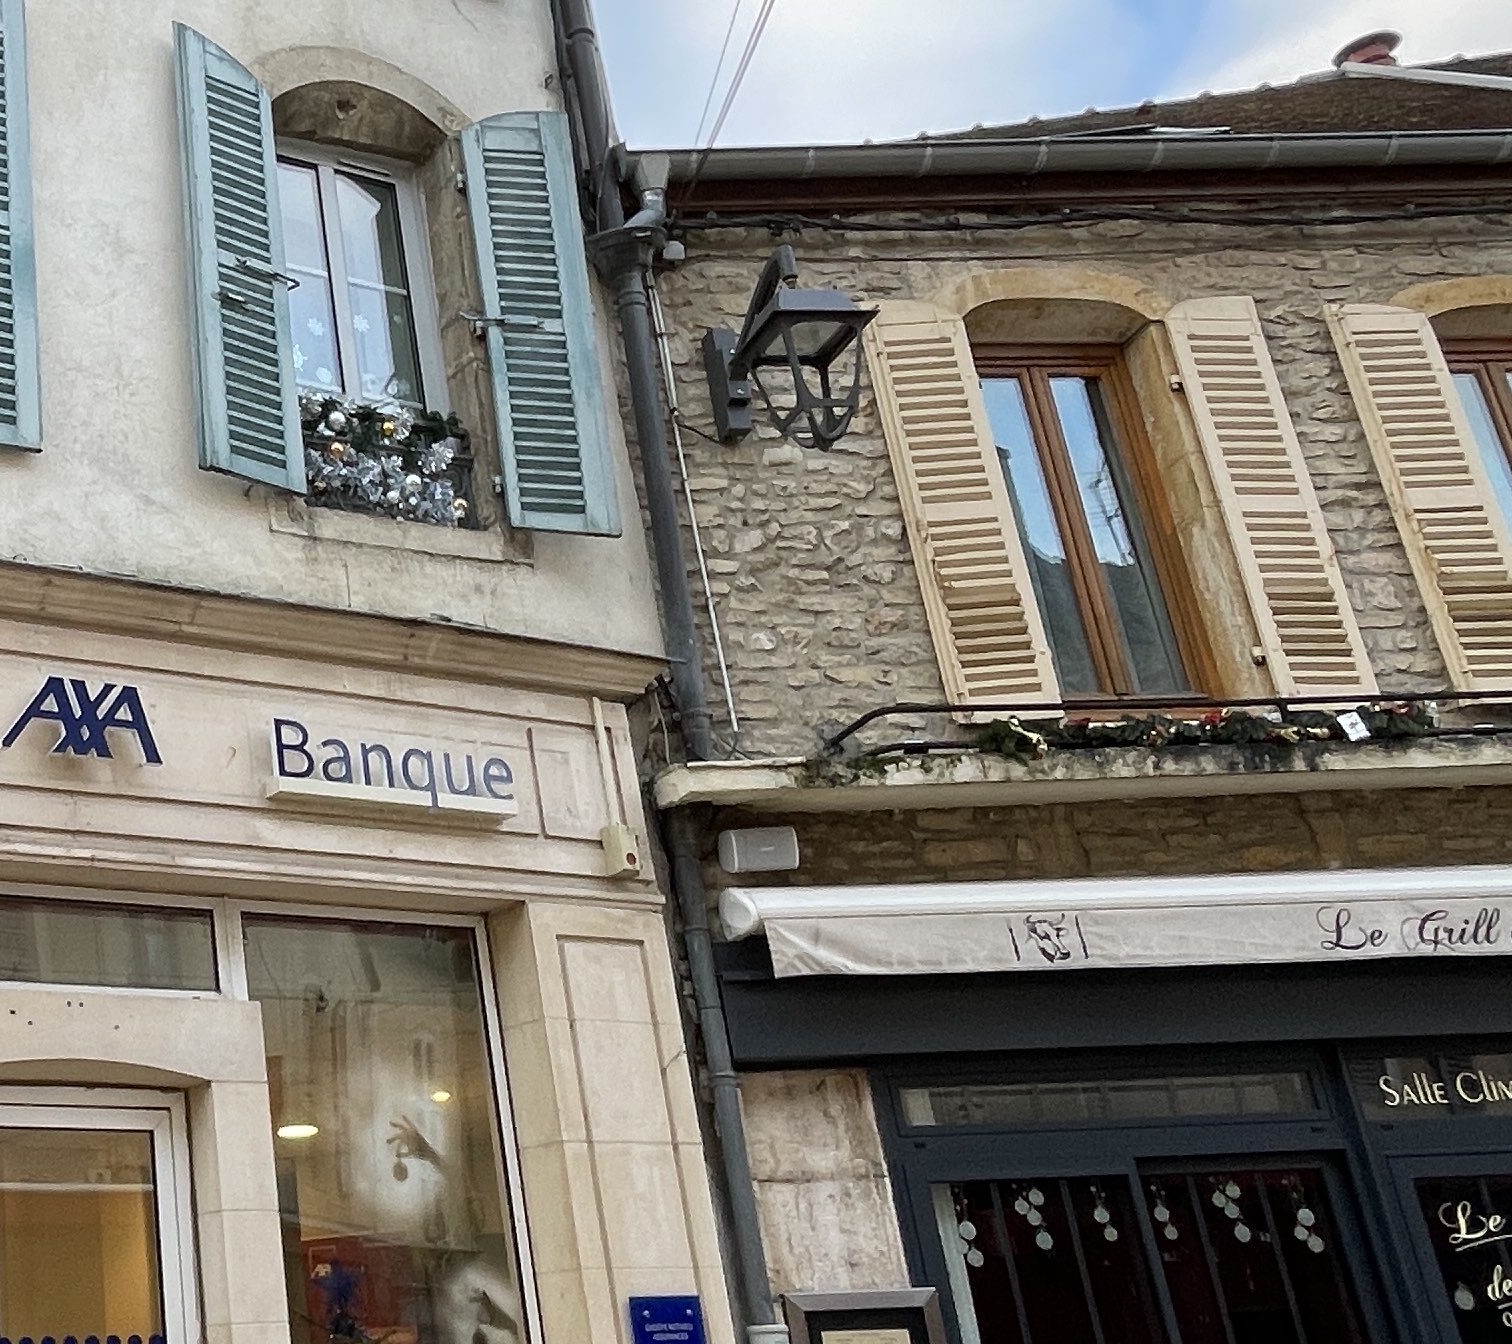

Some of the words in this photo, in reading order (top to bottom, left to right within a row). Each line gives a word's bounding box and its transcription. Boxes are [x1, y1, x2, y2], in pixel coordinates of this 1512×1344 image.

[273, 717, 515, 812] Banque
[1317, 906, 1389, 950] Le
[1400, 907, 1501, 952] Grill
[1438, 1200, 1506, 1244] Le
